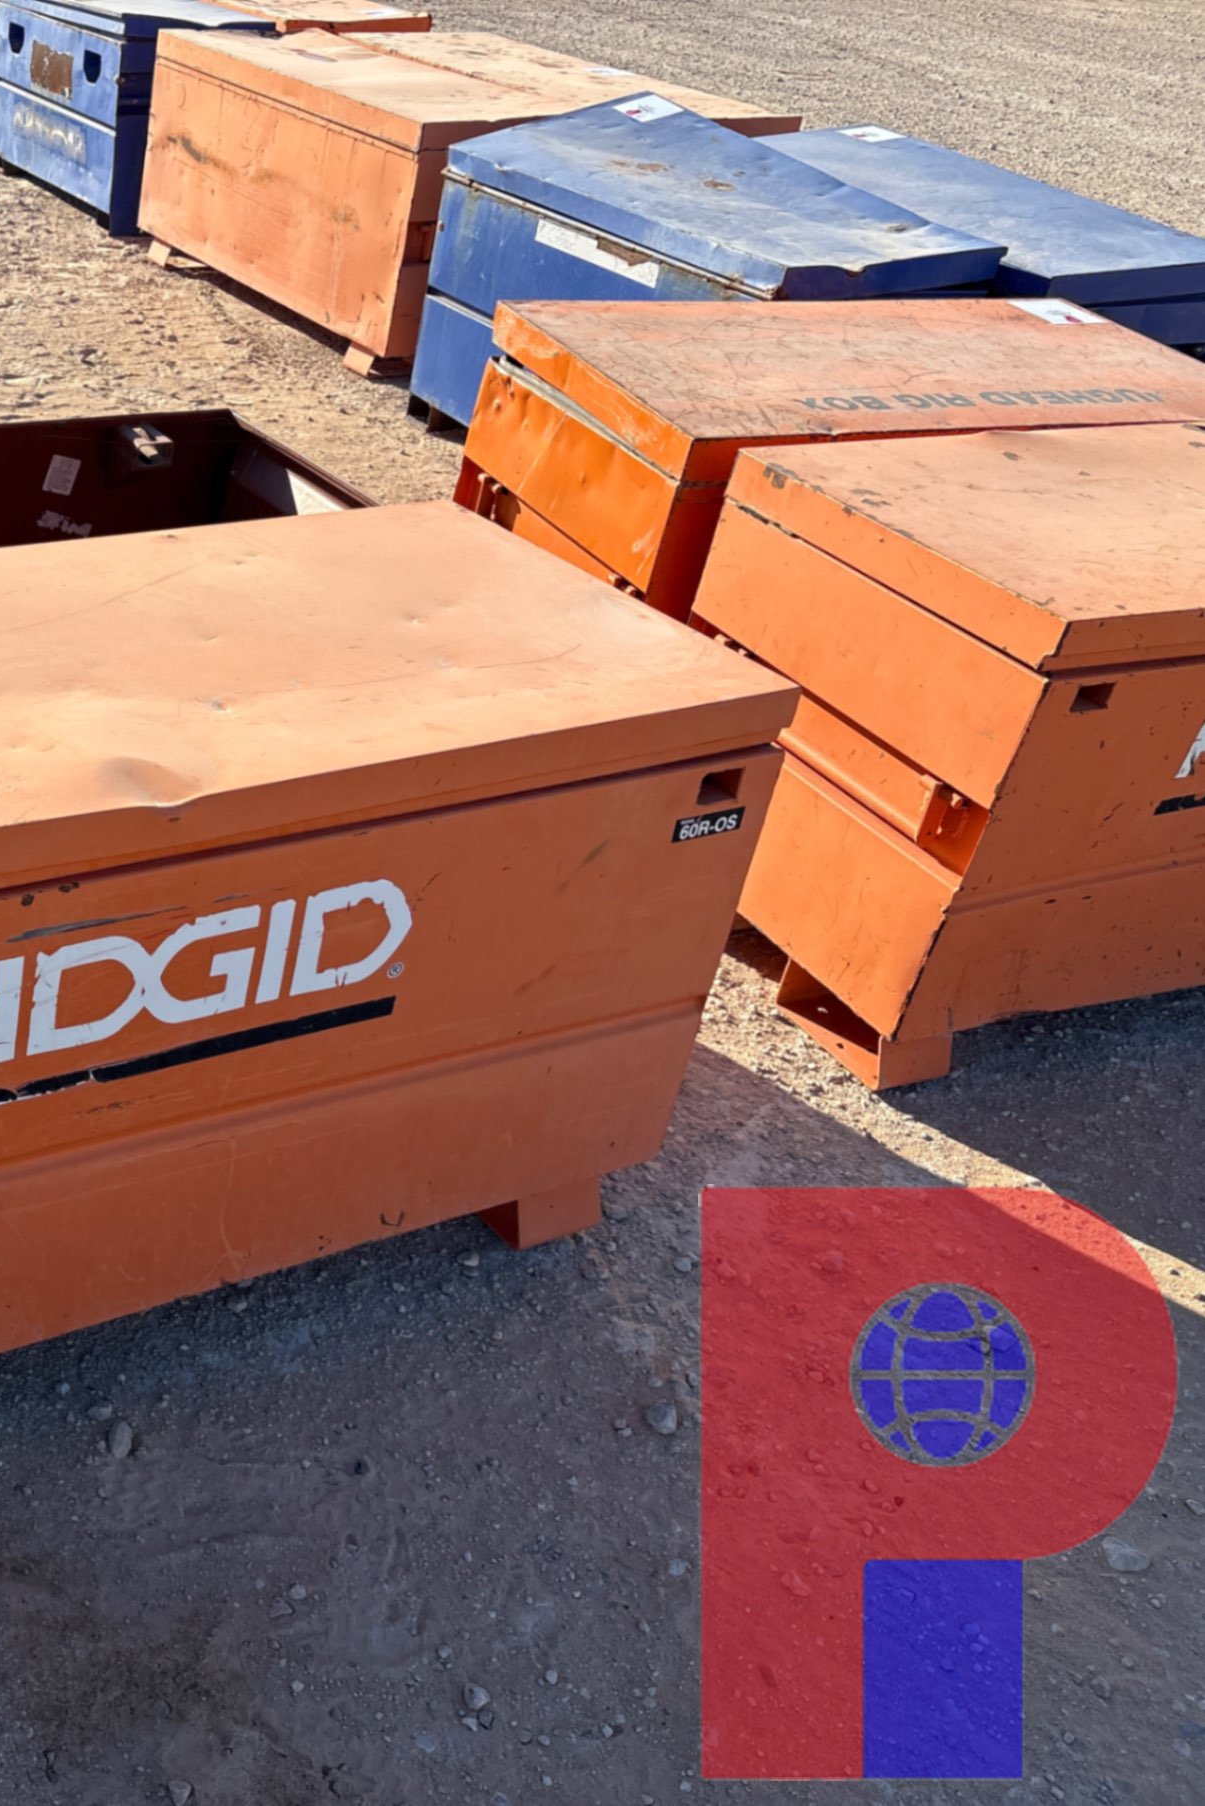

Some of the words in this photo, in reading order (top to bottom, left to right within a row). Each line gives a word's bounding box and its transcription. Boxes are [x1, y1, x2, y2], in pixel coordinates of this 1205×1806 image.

[792, 396, 892, 411] BOX
[892, 393, 977, 409] RIG
[679, 814, 739, 840] 60R-OS
